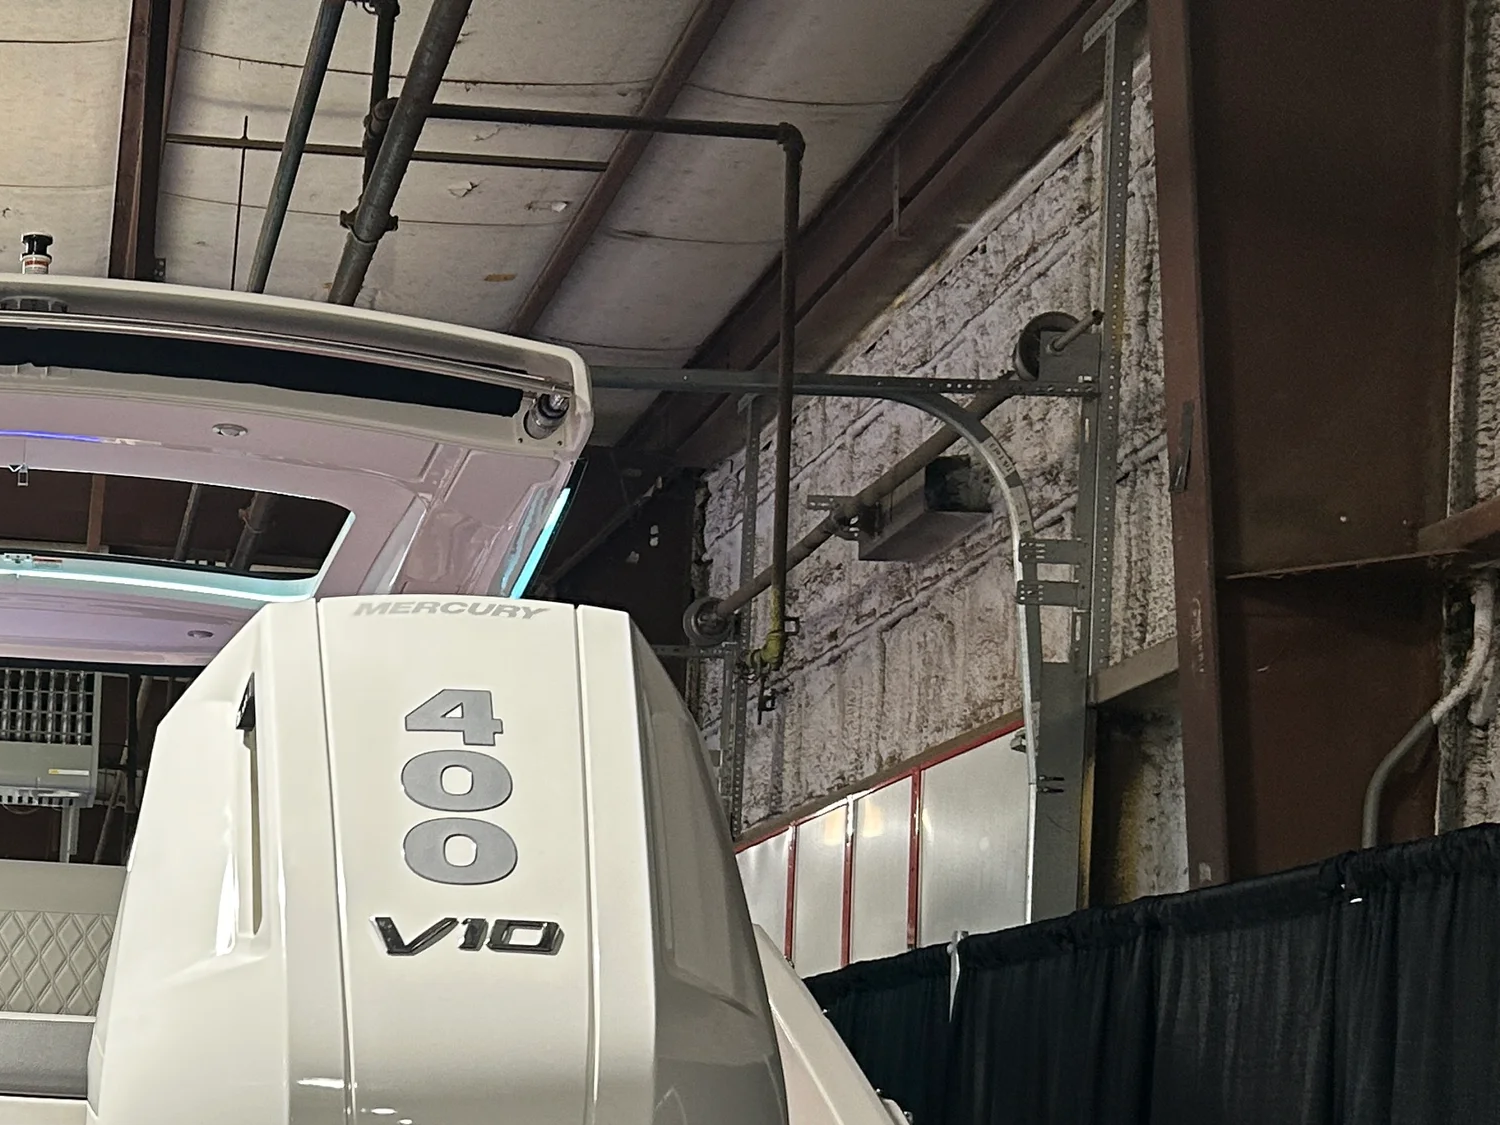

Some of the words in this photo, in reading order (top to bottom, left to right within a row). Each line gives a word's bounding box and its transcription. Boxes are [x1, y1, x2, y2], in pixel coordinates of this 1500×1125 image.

[353, 601, 551, 620] MERCURY
[401, 688, 518, 885] 400
[368, 916, 565, 956] V10
